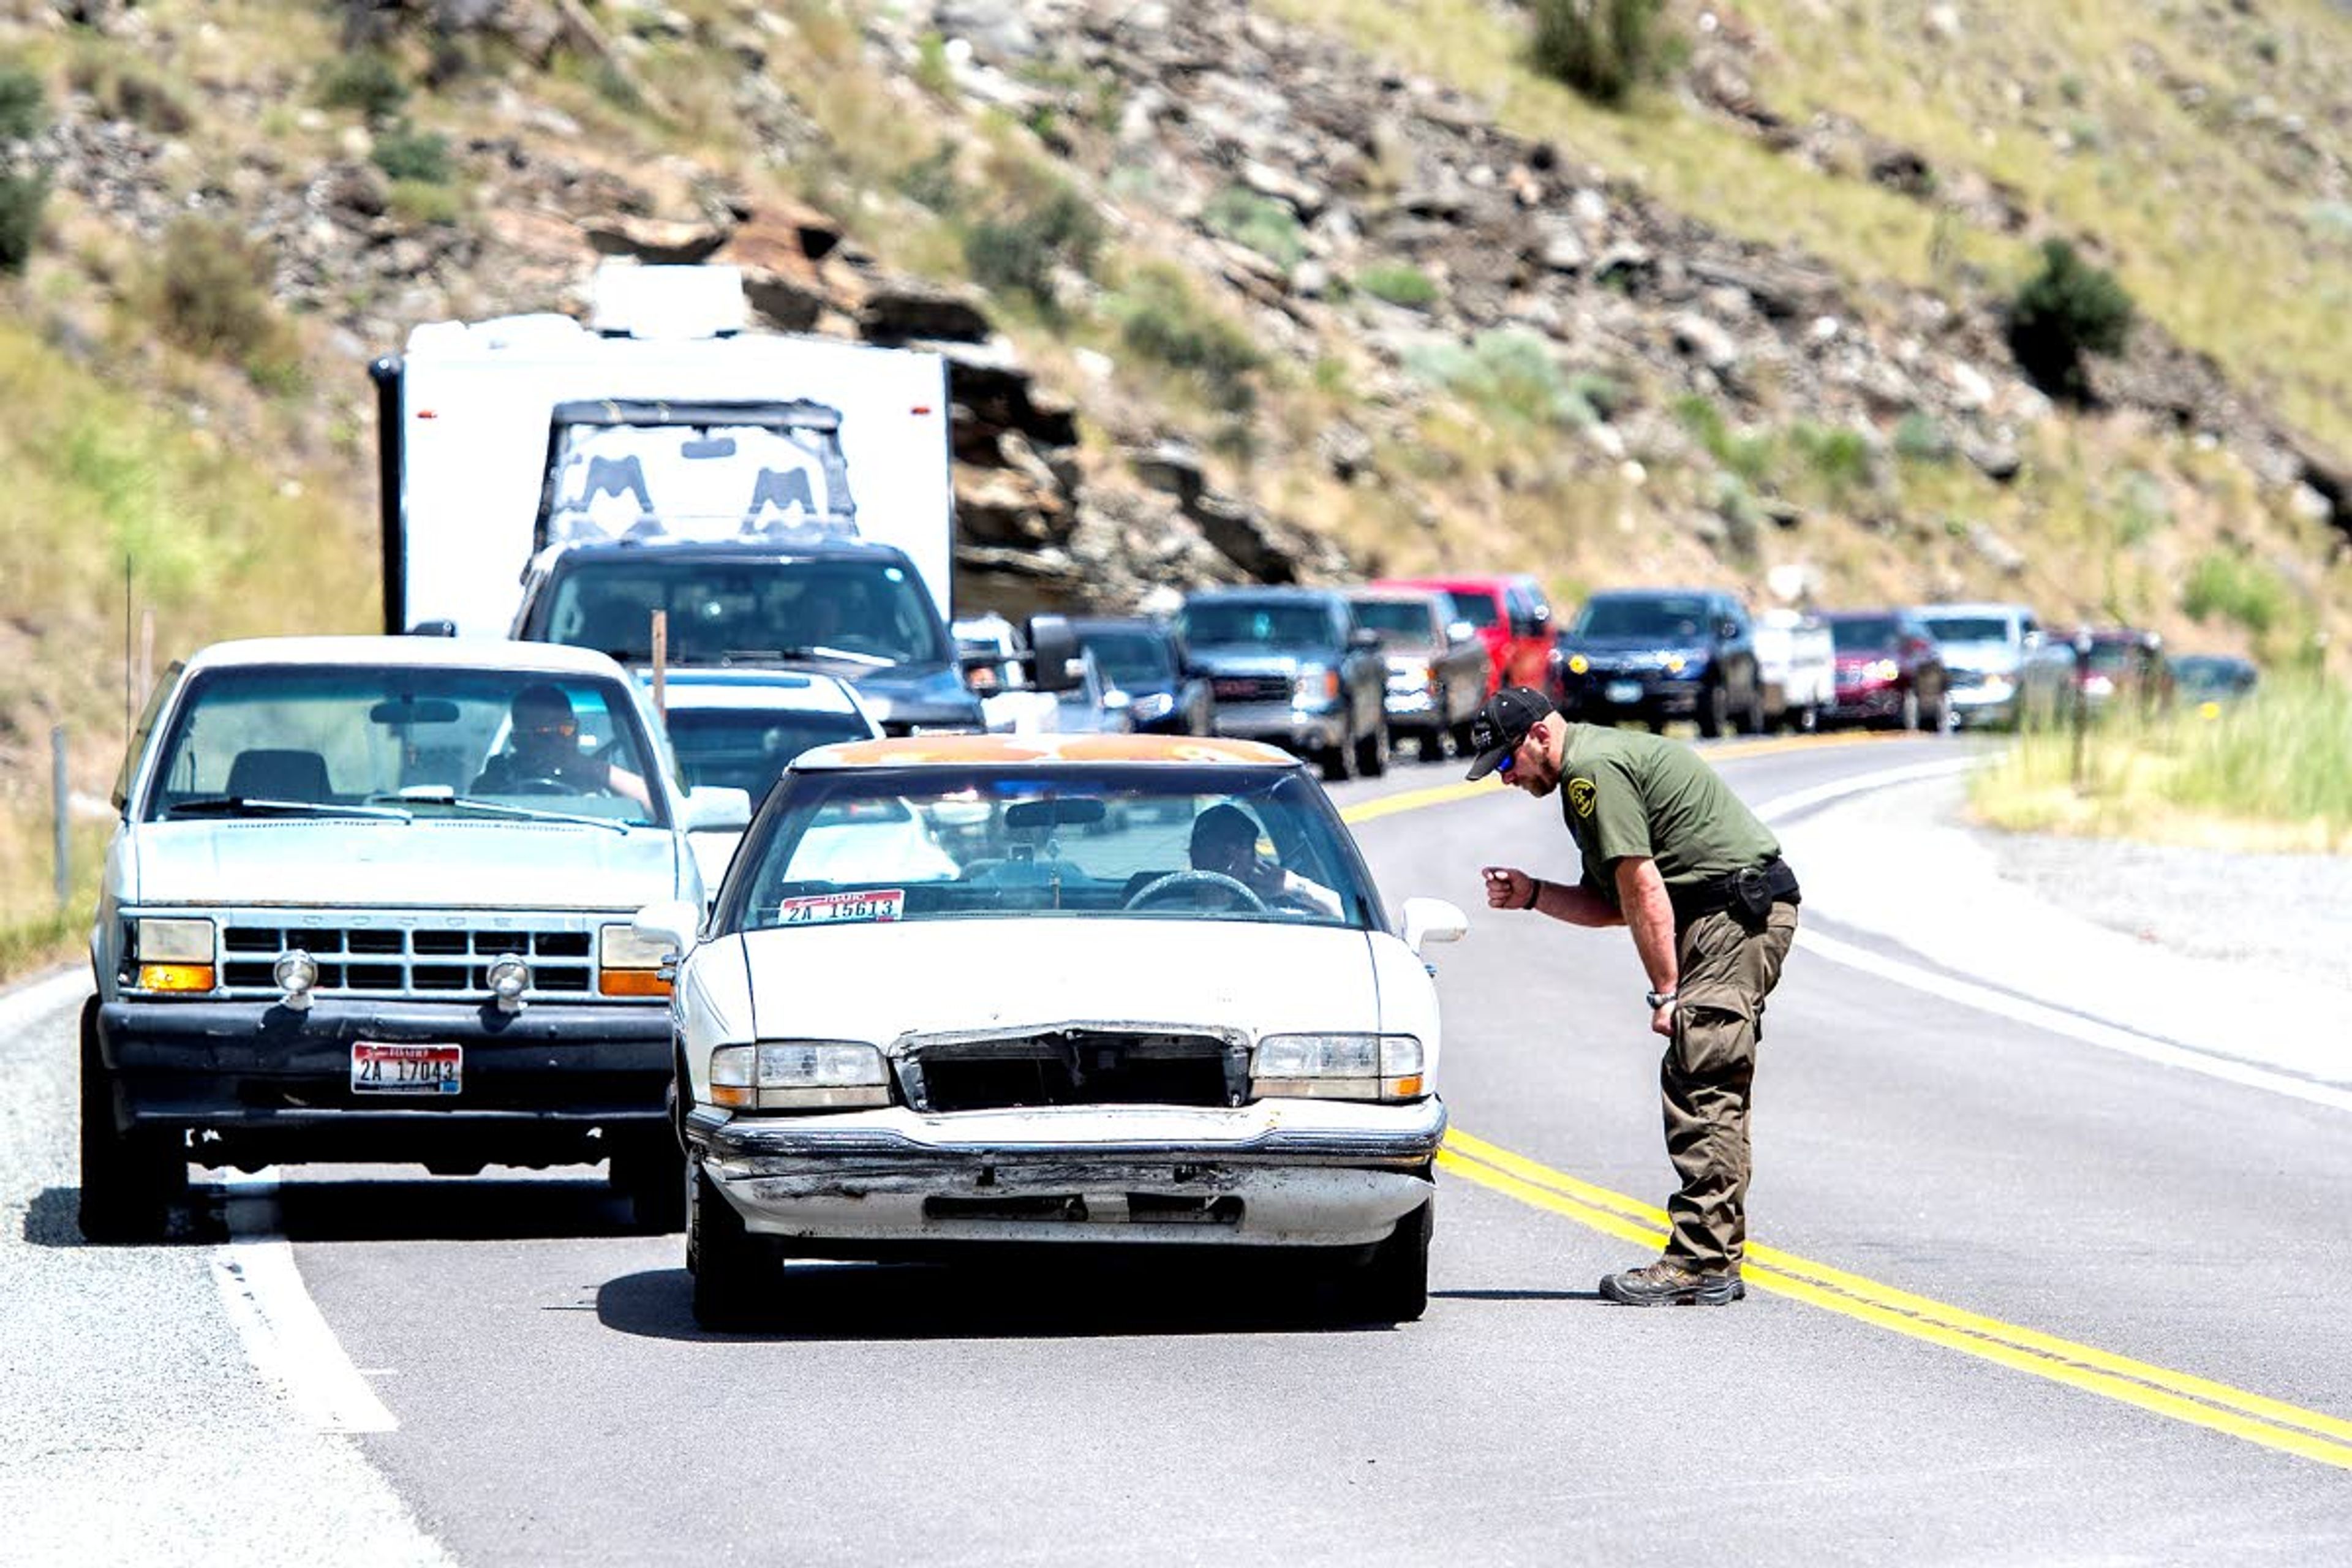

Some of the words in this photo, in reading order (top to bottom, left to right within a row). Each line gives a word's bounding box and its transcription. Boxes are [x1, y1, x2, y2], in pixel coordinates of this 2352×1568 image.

[788, 906, 812, 922] 2A
[829, 900, 893, 918] 15613
[360, 1058, 382, 1081] 2A
[398, 1060, 454, 1082] 17043
